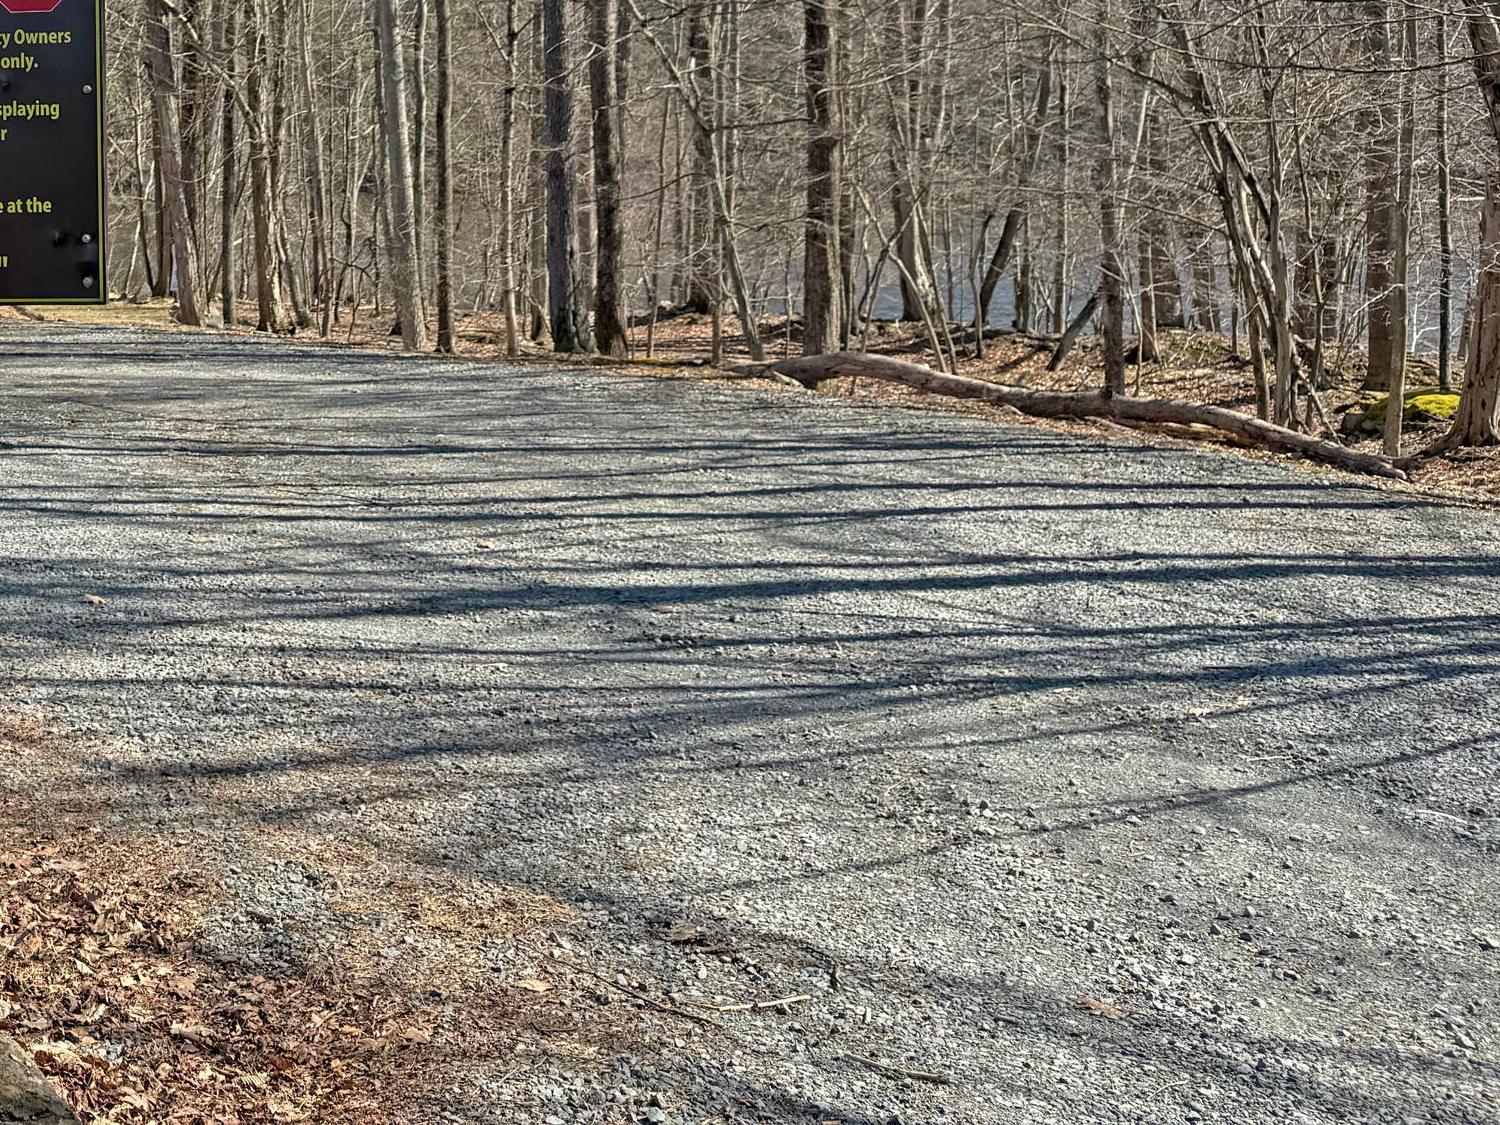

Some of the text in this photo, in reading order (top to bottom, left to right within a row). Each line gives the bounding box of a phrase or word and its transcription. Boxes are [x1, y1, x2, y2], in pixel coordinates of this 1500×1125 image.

[14, 29, 71, 44] Owners
[7, 199, 22, 213] at
[26, 197, 51, 212] the
